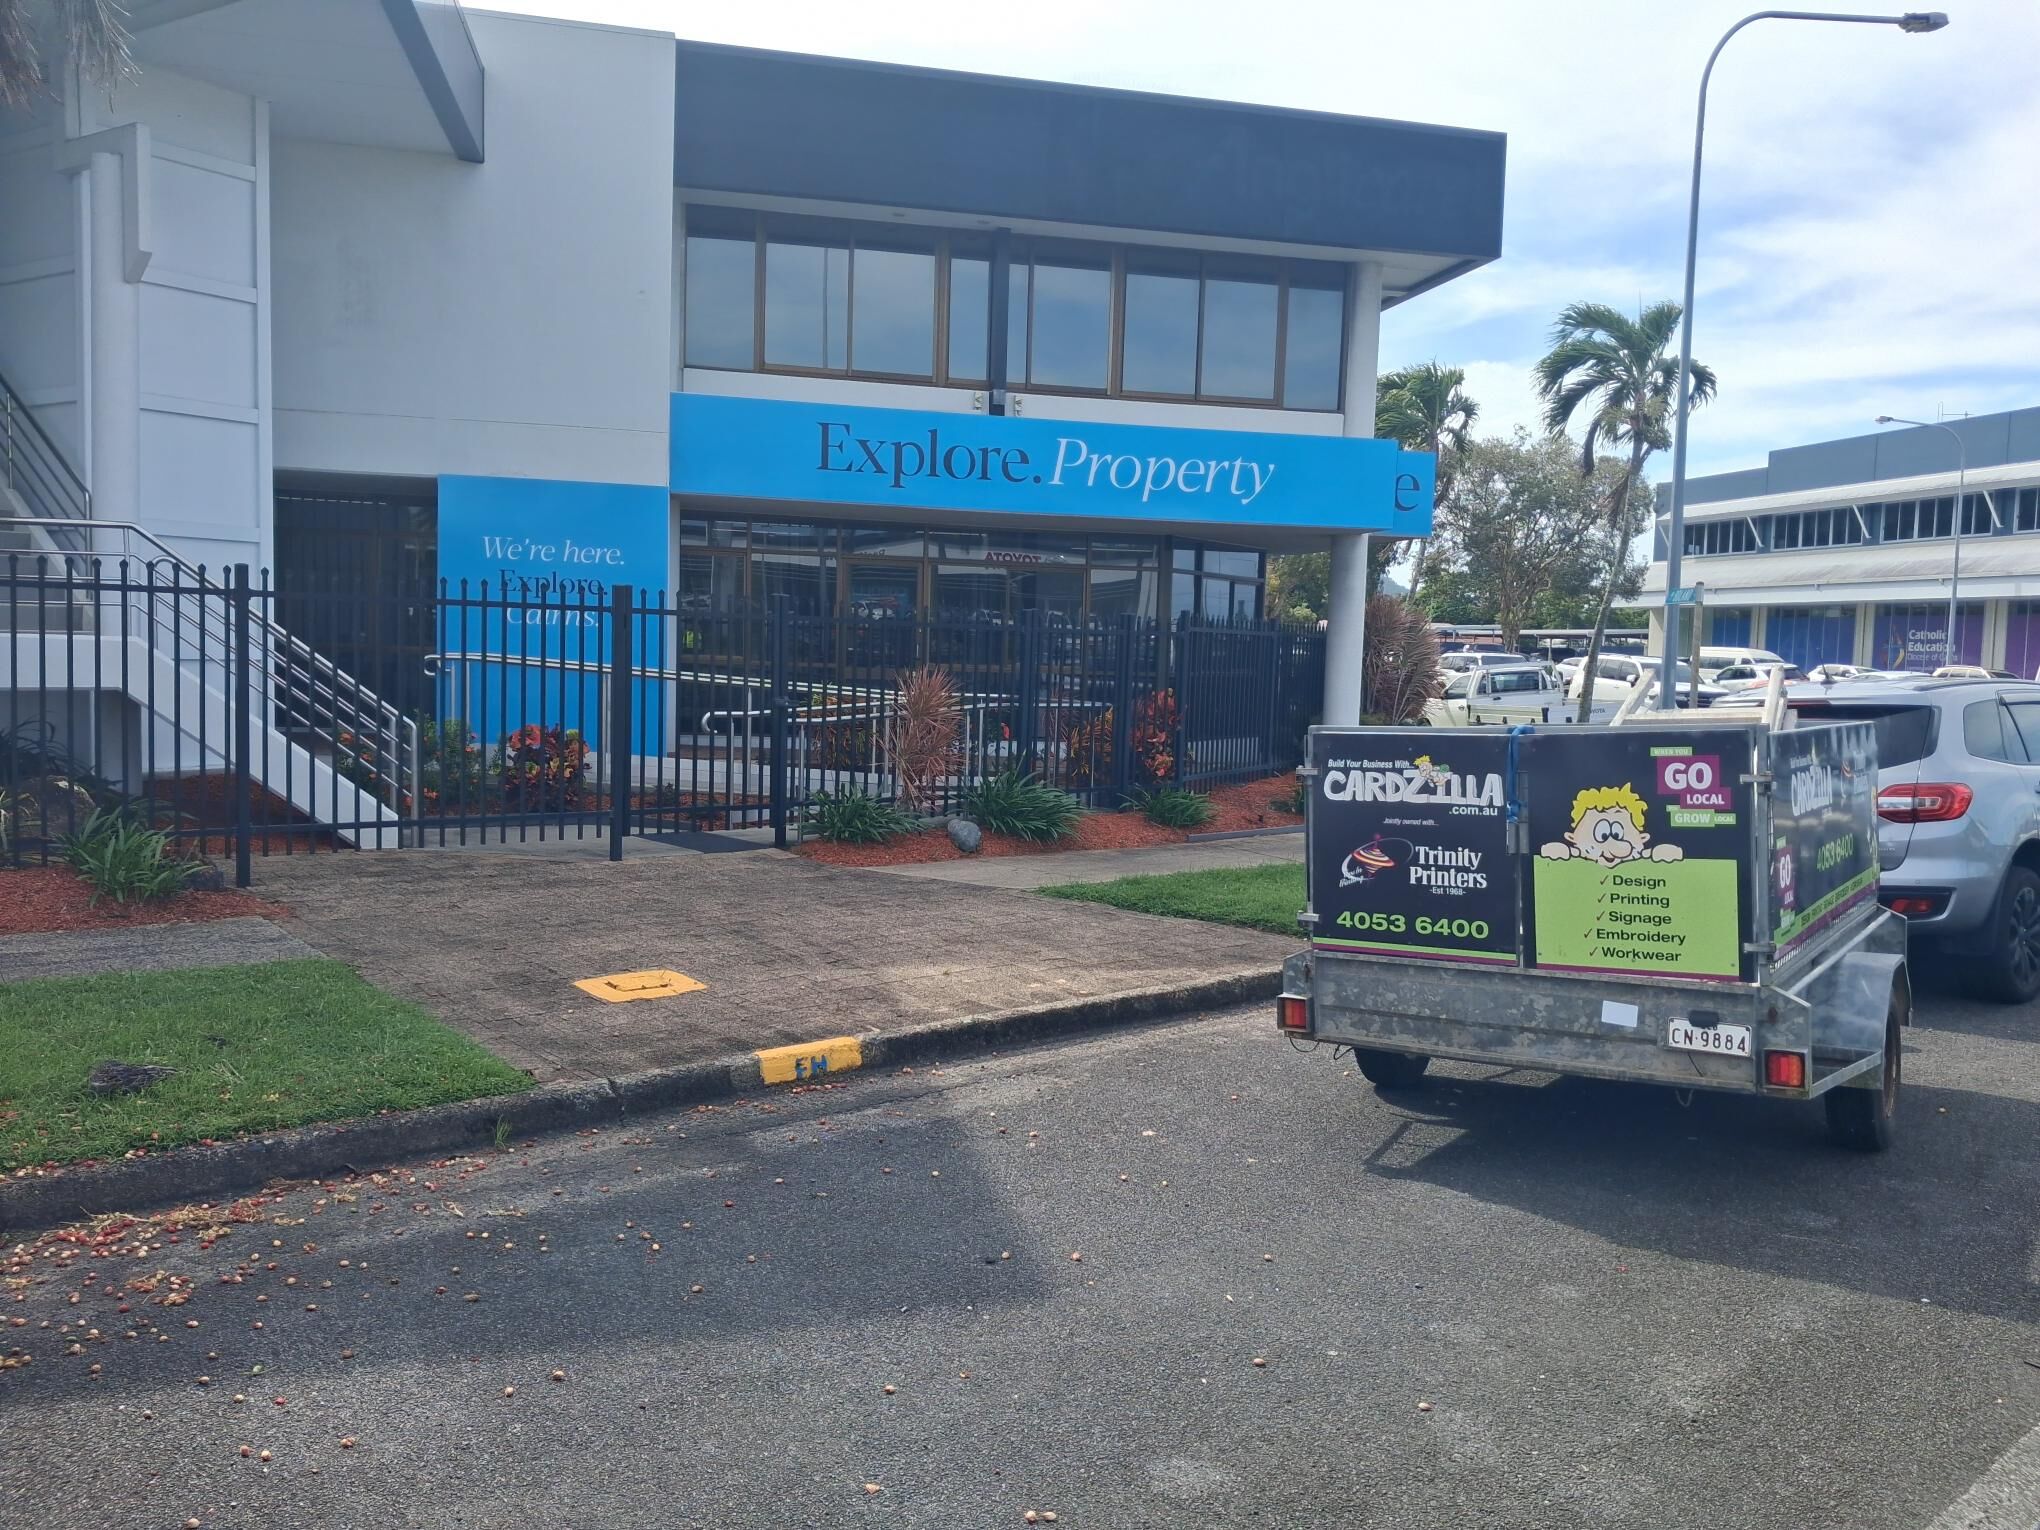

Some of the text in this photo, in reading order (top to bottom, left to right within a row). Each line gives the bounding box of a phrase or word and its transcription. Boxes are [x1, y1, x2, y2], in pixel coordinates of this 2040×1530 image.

[1048, 438, 1275, 505] Property
[482, 536, 625, 565] We're here.
[499, 569, 608, 599] Explore.
[1908, 629, 1948, 640] Catholic
[1328, 759, 1345, 768] Build
[1346, 760, 1361, 768] Your
[1362, 760, 1393, 769] Business
[1664, 762, 1712, 790] GO
[1324, 770, 1504, 807] CARDZILLA
[1686, 793, 1725, 805] LOCAL
[1449, 806, 1499, 816] .com.au
[1674, 813, 1734, 824] GROW LOCAL
[1415, 846, 1482, 870] Trinity
[1409, 866, 1487, 889] Printers
[1780, 854, 1791, 888] GO
[1613, 875, 1666, 890] Design
[1610, 893, 1670, 908] Printing
[1336, 911, 1489, 939] 4053 6400
[1609, 911, 1672, 926] Signage
[1596, 928, 1686, 946] Embroidery
[1602, 946, 1682, 961] Workwear
